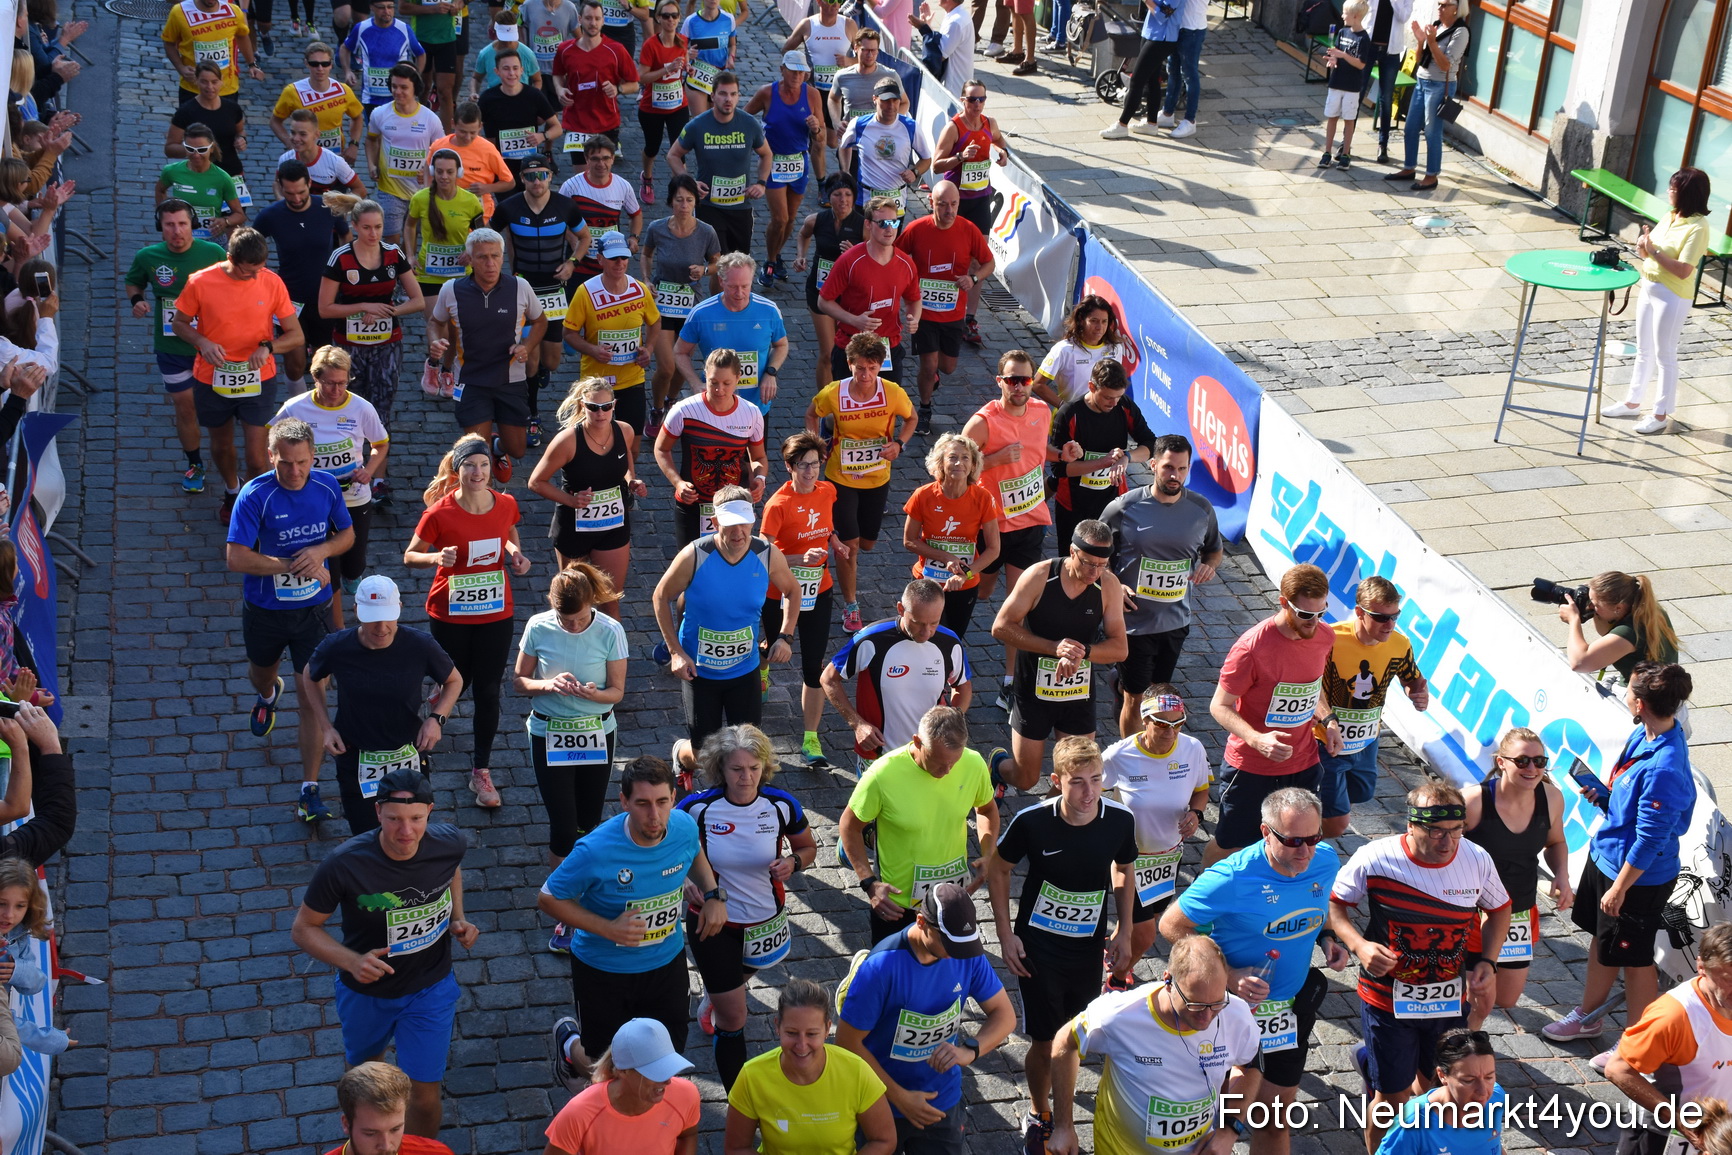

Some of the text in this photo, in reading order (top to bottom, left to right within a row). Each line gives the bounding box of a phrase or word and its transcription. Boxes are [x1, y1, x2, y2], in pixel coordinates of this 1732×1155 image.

[604, 8, 627, 19] 2306
[191, 20, 238, 37] MAX BÖGL
[196, 40, 228, 51] BOCK
[373, 67, 390, 77] BOC
[371, 77, 389, 88] 225
[655, 80, 681, 91] BOCK
[656, 90, 680, 102] 2561
[327, 98, 348, 110] BÖGL
[319, 128, 341, 139] OCK
[704, 131, 746, 145] CrossFit
[316, 137, 337, 148] 407
[391, 148, 426, 160] BOCK
[393, 158, 422, 170] 1377
[775, 162, 801, 173] 2305
[964, 162, 991, 171] BOCK
[715, 175, 746, 187] BOCK
[716, 186, 742, 198] 1202
[718, 196, 739, 204] STEFAN
[429, 244, 464, 254] BOCK
[923, 280, 957, 291] BOCK
[540, 296, 562, 310] 351
[657, 293, 690, 307] 2330
[922, 290, 954, 303] 2565
[596, 310, 622, 322] MAX
[661, 306, 684, 315] JUDITH
[353, 320, 388, 333] 1220
[356, 334, 382, 342] SABINE
[601, 330, 638, 341] BOCK
[1145, 335, 1168, 360] STORE
[219, 372, 257, 386] 1392
[1151, 361, 1172, 390] ONLINE
[231, 386, 246, 395] Maik
[1149, 388, 1171, 418] MOBILE
[840, 409, 889, 422] MAX BÖGL
[1191, 380, 1251, 481] Hervis
[845, 439, 883, 450] BOCK
[312, 452, 351, 469] 2708
[847, 448, 882, 463] 1237
[1003, 468, 1041, 491] BOCK
[591, 490, 618, 502] OCK
[1008, 481, 1041, 504] 1149
[1008, 493, 1042, 513] SEBASTIAN
[581, 501, 621, 519] 2726
[278, 521, 327, 541] SYSCAD
[797, 526, 829, 541] funrunners
[1145, 560, 1187, 572] BOCK
[453, 573, 499, 588] BOCK
[933, 570, 954, 580] HELG
[1145, 573, 1184, 589] 1154
[292, 585, 315, 597] MARC
[455, 586, 498, 603] 2581
[1142, 588, 1183, 599] ALEXANDER
[461, 602, 494, 612] MARINA
[703, 629, 749, 642] BOCK
[704, 642, 748, 658] 2636
[888, 664, 904, 676] tkn
[1041, 687, 1083, 698] MATTHIAS
[1278, 681, 1320, 696] BOCK
[1275, 695, 1316, 713] 2035
[1336, 708, 1379, 721] BOCK
[551, 718, 599, 731] BOCK
[553, 732, 599, 749] 2801
[365, 749, 414, 764] BOCK
[567, 751, 587, 761] RITA
[1167, 762, 1179, 771] 20
[661, 863, 685, 877] BOCK
[920, 859, 966, 879] BOCK
[1135, 864, 1172, 888] 2808
[1045, 885, 1101, 905] BOCK
[1442, 887, 1476, 896] NEUMARKT
[393, 893, 452, 924] BOCK
[1040, 899, 1094, 922] 2622
[644, 906, 679, 929] 189
[395, 909, 449, 942] 2438
[748, 914, 790, 937] BOCK
[1048, 920, 1080, 933] LOUIS
[402, 928, 443, 951] ROBERT
[643, 928, 668, 941] ETER
[750, 926, 789, 957] 2809
[1499, 945, 1527, 957] ATHRIN
[1400, 983, 1456, 1002] 2320
[1256, 1000, 1292, 1016] OCK
[1406, 1002, 1448, 1013] CHARLY
[905, 1001, 959, 1028] BOCK
[1256, 1012, 1289, 1036] 365
[902, 1020, 955, 1047] 2253
[1261, 1034, 1288, 1048] PHAN
[906, 1044, 939, 1059] JÜRG
[1199, 1043, 1213, 1055] 20
[1135, 1055, 1163, 1065] BOCK
[1198, 1051, 1230, 1063] Neumarkter
[1198, 1059, 1226, 1069] Stadtlauf
[1155, 1097, 1214, 1115] BOCK
[1156, 1107, 1211, 1137] 1055
[1162, 1128, 1204, 1149] STEFAN
